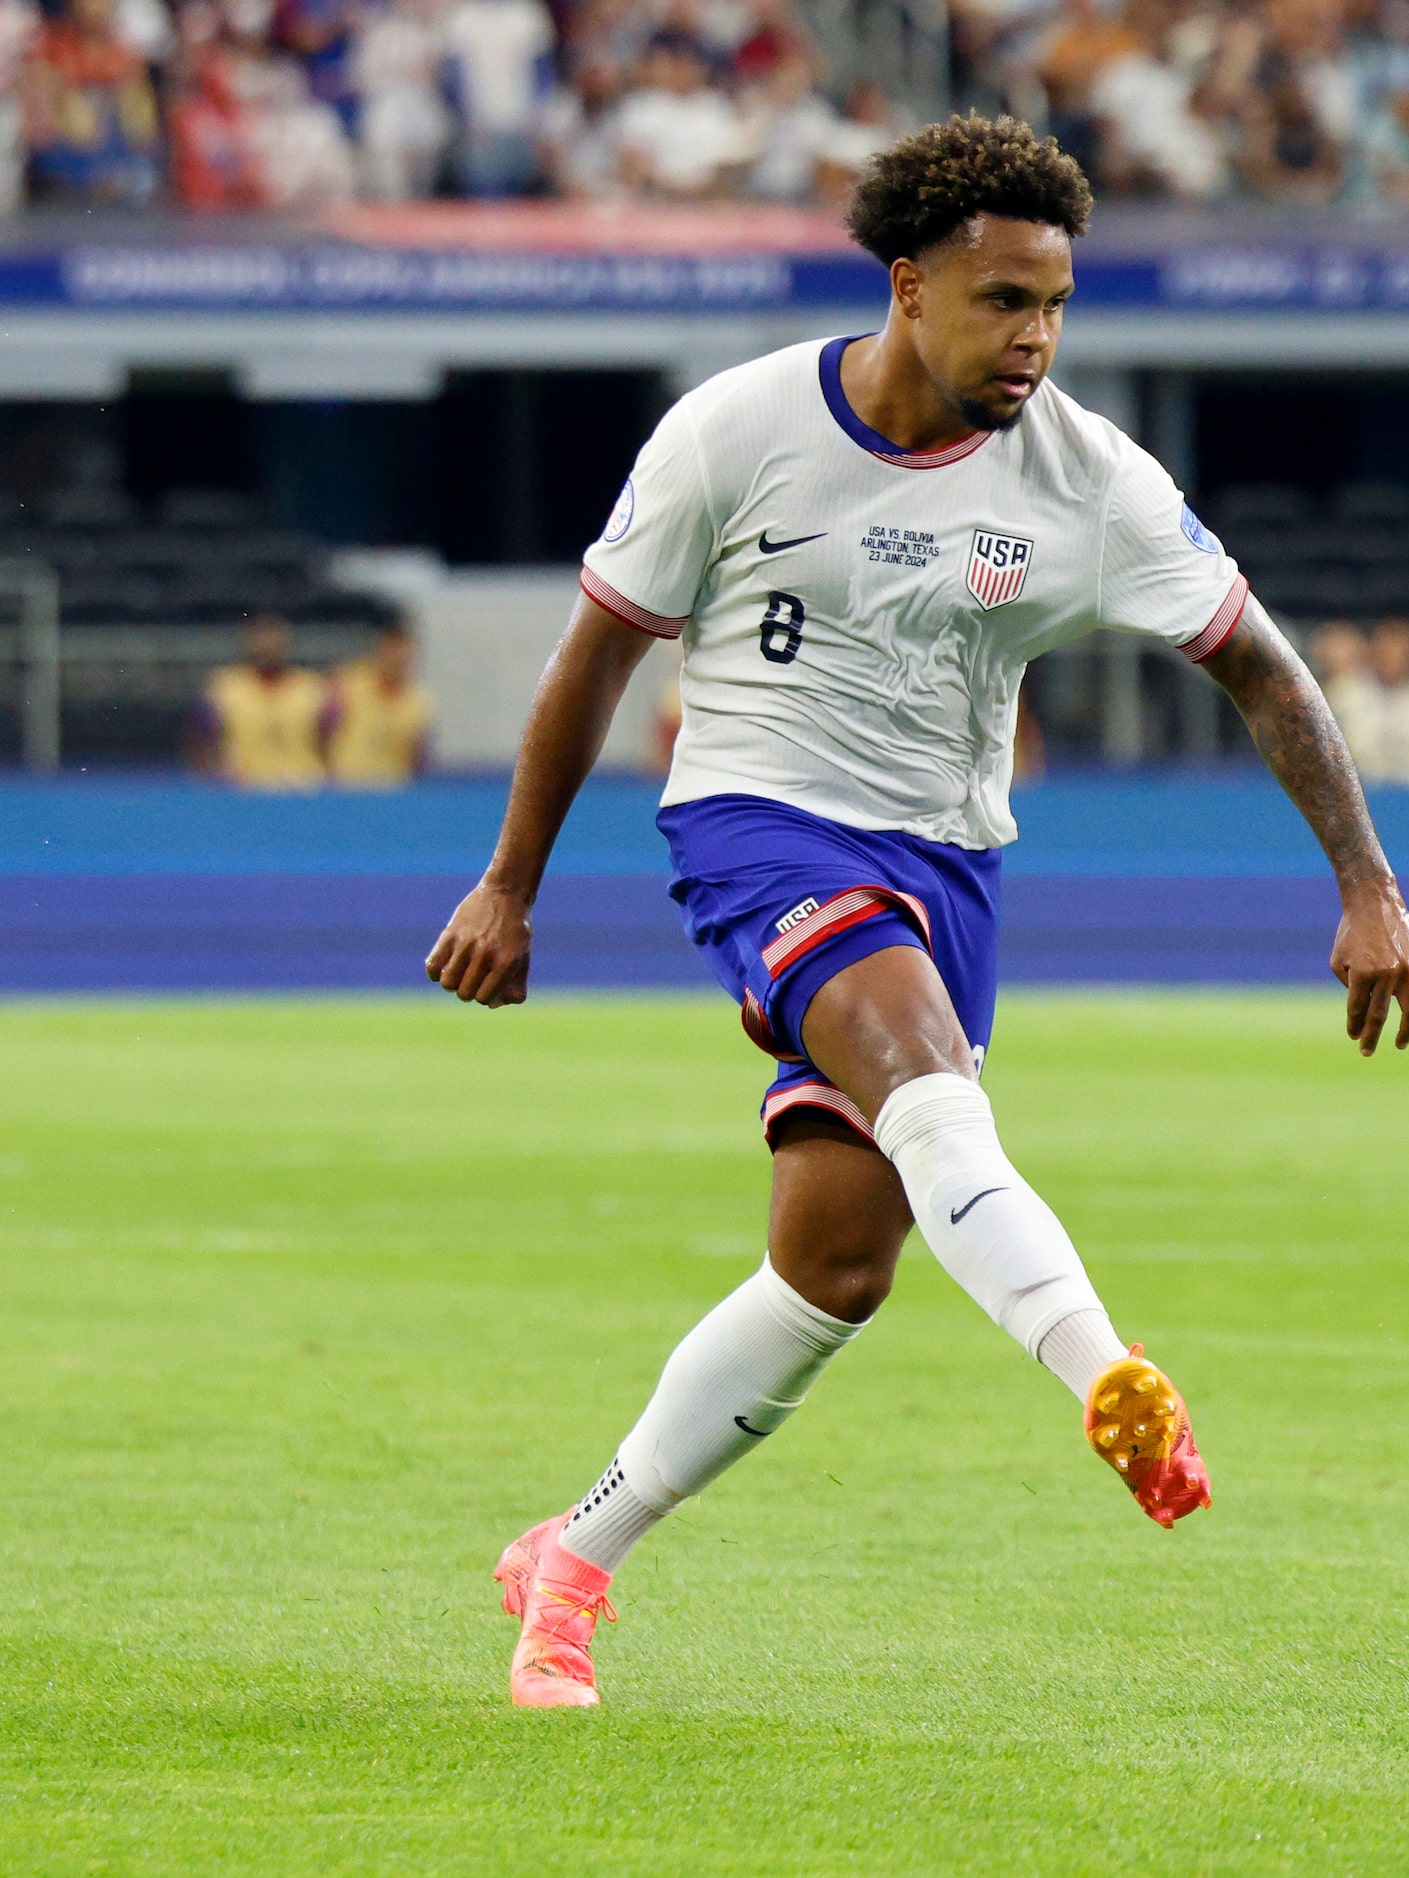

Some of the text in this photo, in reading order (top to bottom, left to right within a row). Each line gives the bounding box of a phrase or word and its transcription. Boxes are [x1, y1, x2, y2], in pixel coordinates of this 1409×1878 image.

[868, 526, 885, 538] USA
[903, 530, 934, 544] BOLIVIA
[869, 551, 927, 567] 23 JUNE 2024
[912, 544, 940, 557] TEXAS
[977, 535, 1028, 567] USA
[760, 591, 804, 664] 8
